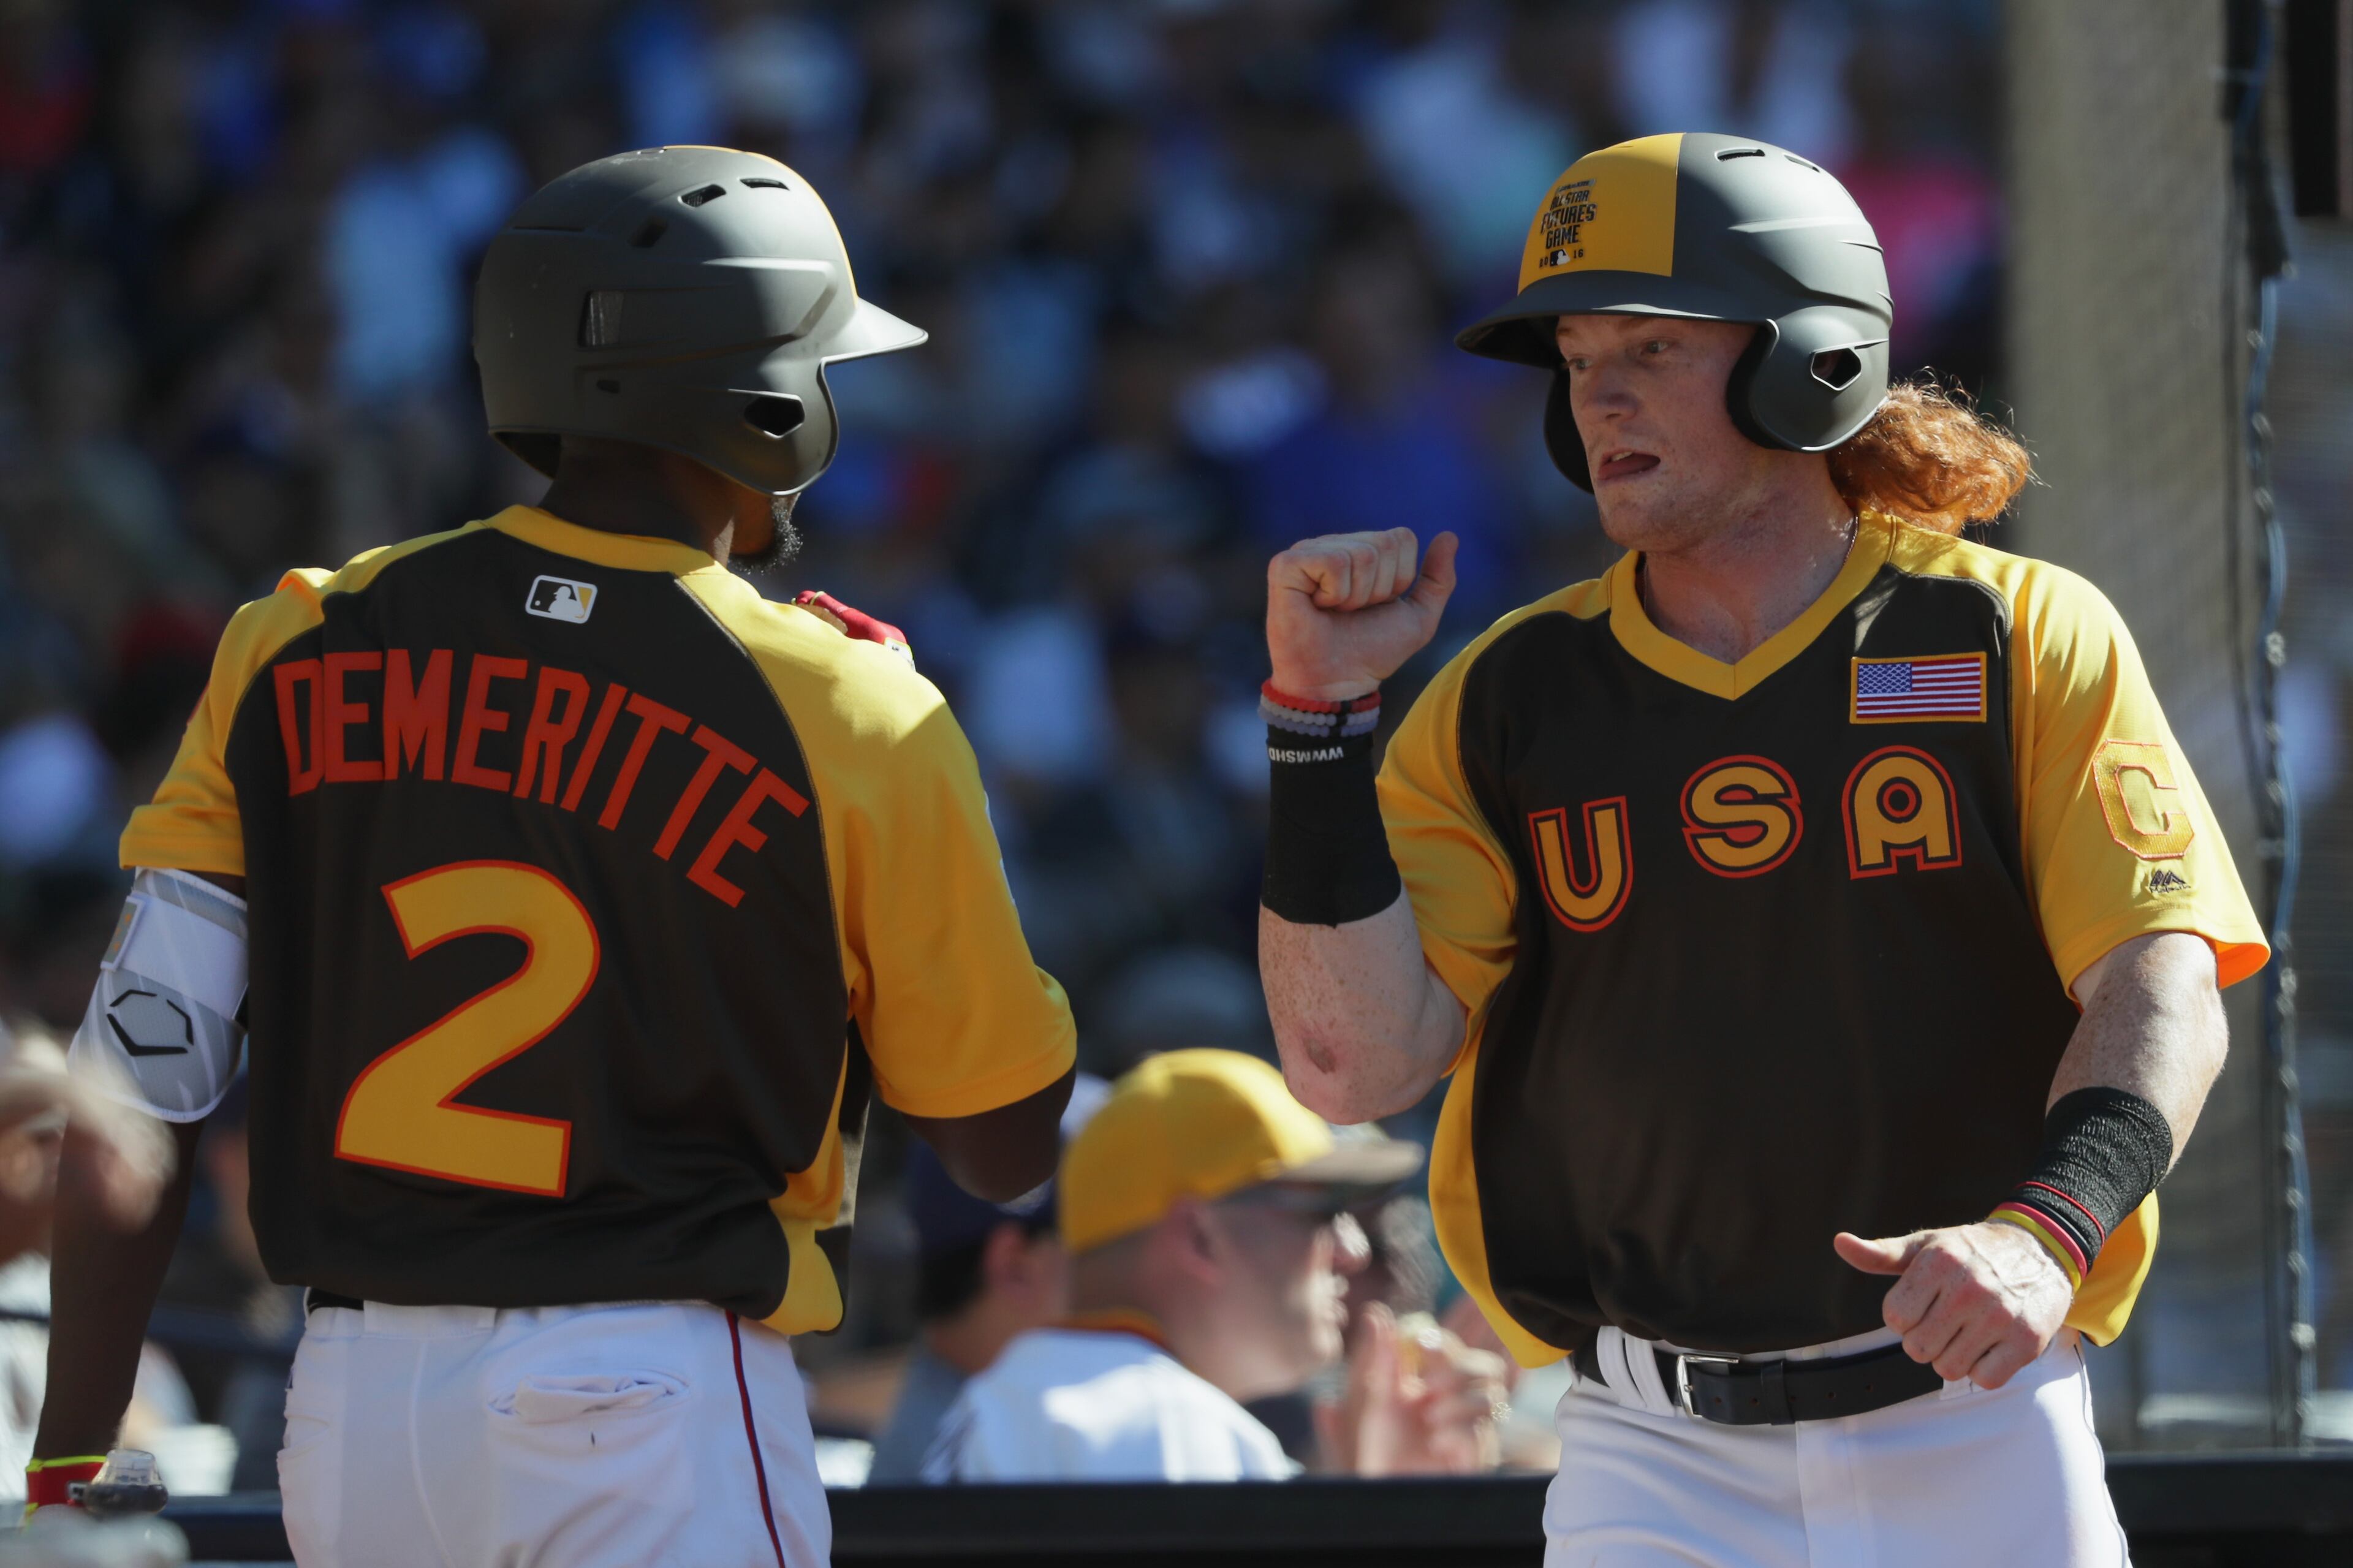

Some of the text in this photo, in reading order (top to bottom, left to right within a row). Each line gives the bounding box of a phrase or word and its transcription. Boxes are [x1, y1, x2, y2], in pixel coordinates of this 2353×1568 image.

[1540, 204, 1597, 235] FUTURES
[1546, 224, 1580, 249] GAME
[273, 648, 810, 909] DEMERITTE
[1528, 744, 1962, 933] USA
[2093, 739, 2194, 858] C
[334, 859, 601, 1198] 2
